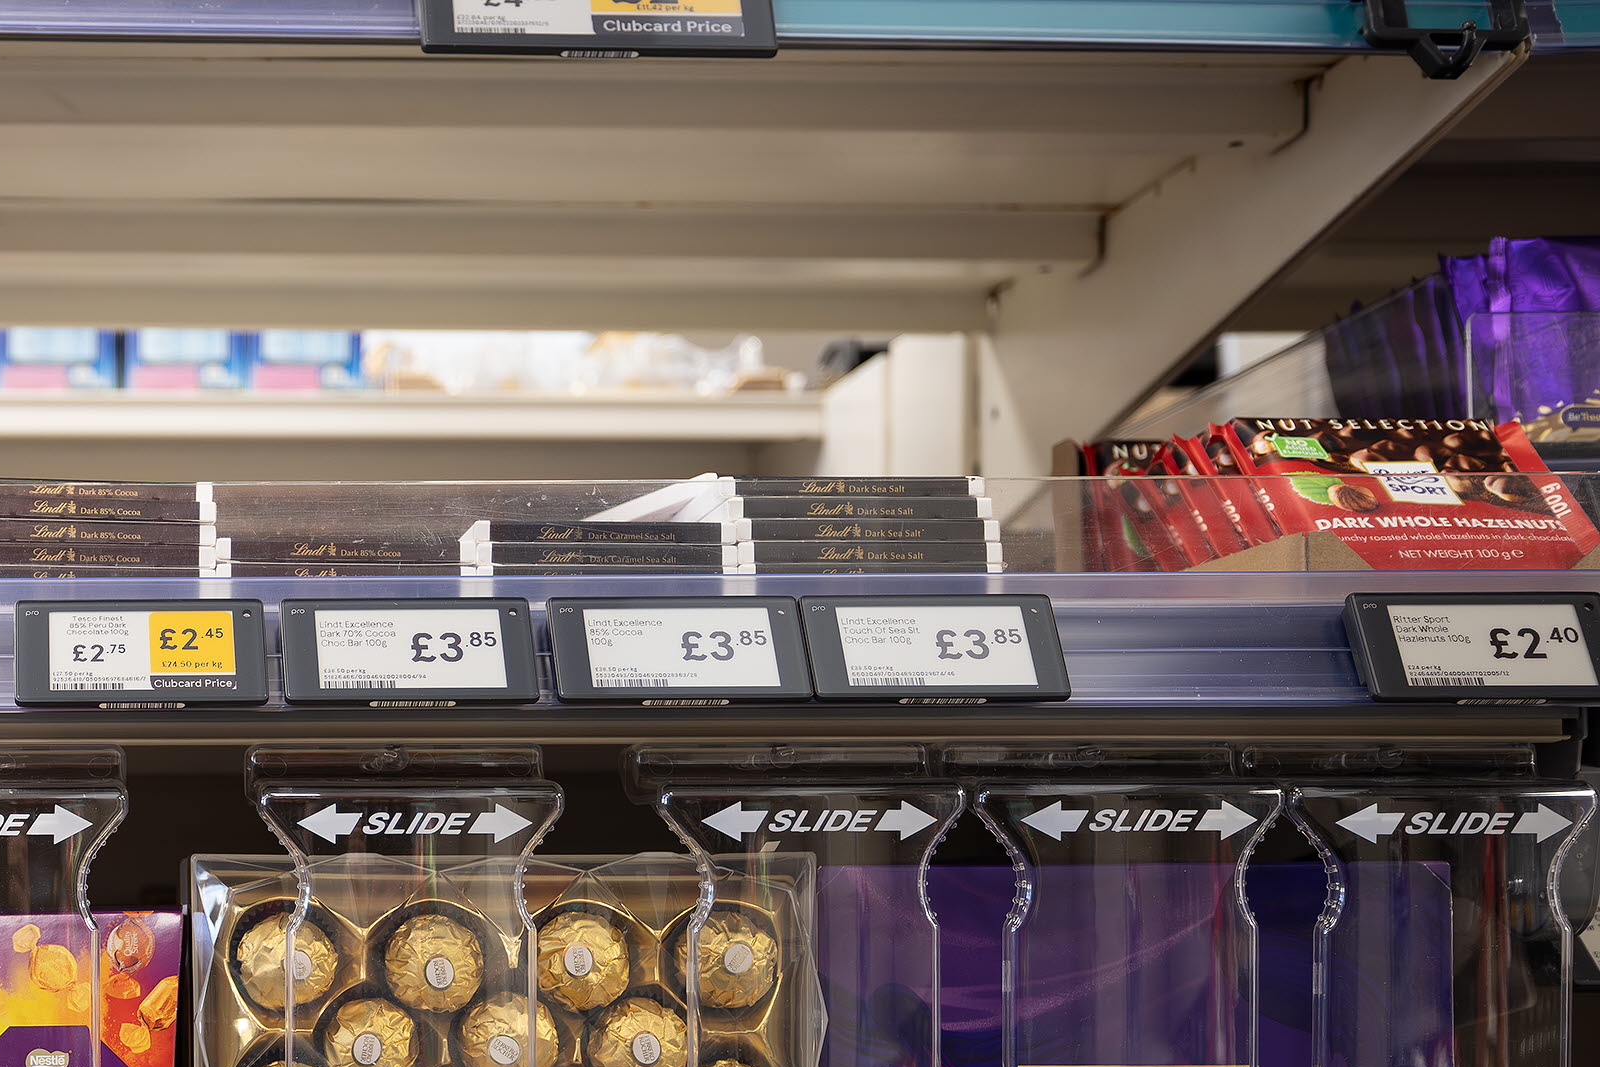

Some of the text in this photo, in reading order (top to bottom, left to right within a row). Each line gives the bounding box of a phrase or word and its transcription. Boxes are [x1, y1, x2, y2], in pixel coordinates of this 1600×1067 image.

[1255, 419, 1490, 432] NUT SELECTION
[1388, 484, 1448, 497] SPORT
[30, 501, 68, 513] Lindt
[80, 507, 98, 515] Dark
[536, 526, 675, 540] Lindt Dark Caramel Sea Salt
[1315, 516, 1568, 532] DARK WHOLE HAZELNUTS
[159, 628, 224, 650] £2.45
[411, 631, 497, 663] £3.85
[1489, 627, 1579, 660] £2.40
[72, 644, 126, 662] £2.75
[363, 811, 471, 835] SLIDE
[768, 809, 877, 833] SLIDE
[1088, 809, 1198, 833] SLIDE
[1405, 811, 1514, 835] SLIDE
